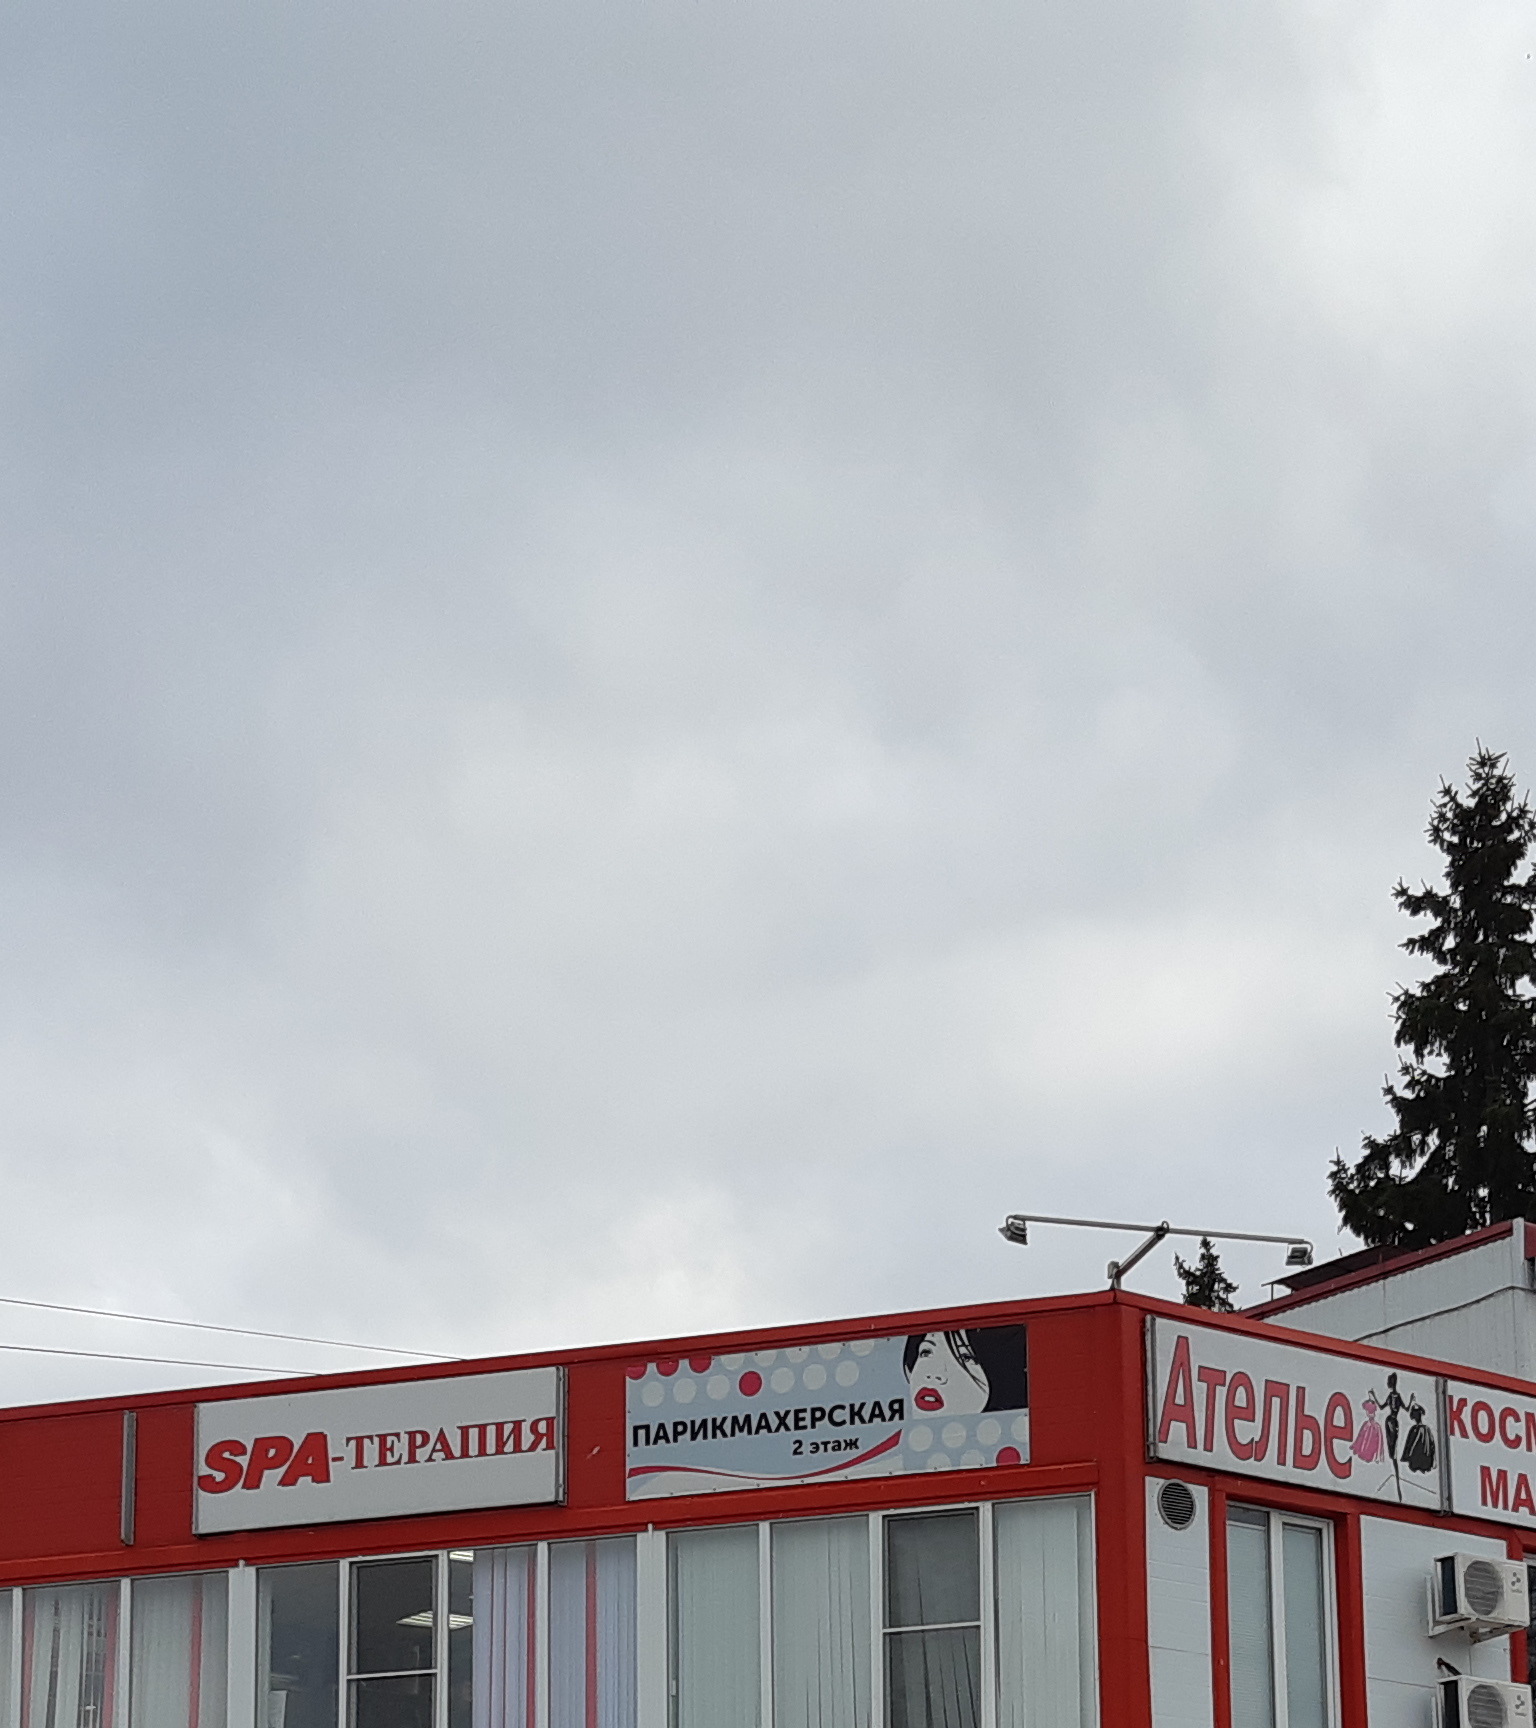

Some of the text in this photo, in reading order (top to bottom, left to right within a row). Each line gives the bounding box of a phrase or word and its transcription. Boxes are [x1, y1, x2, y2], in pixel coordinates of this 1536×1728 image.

[632, 1398, 905, 1447] ПАРИКМАХЕРСКАЯ
[1158, 1335, 1354, 1480] Ателье
[197, 1416, 557, 1495] SPA-ТЕРАПИЯ
[792, 1436, 860, 1456] 2 этаж
